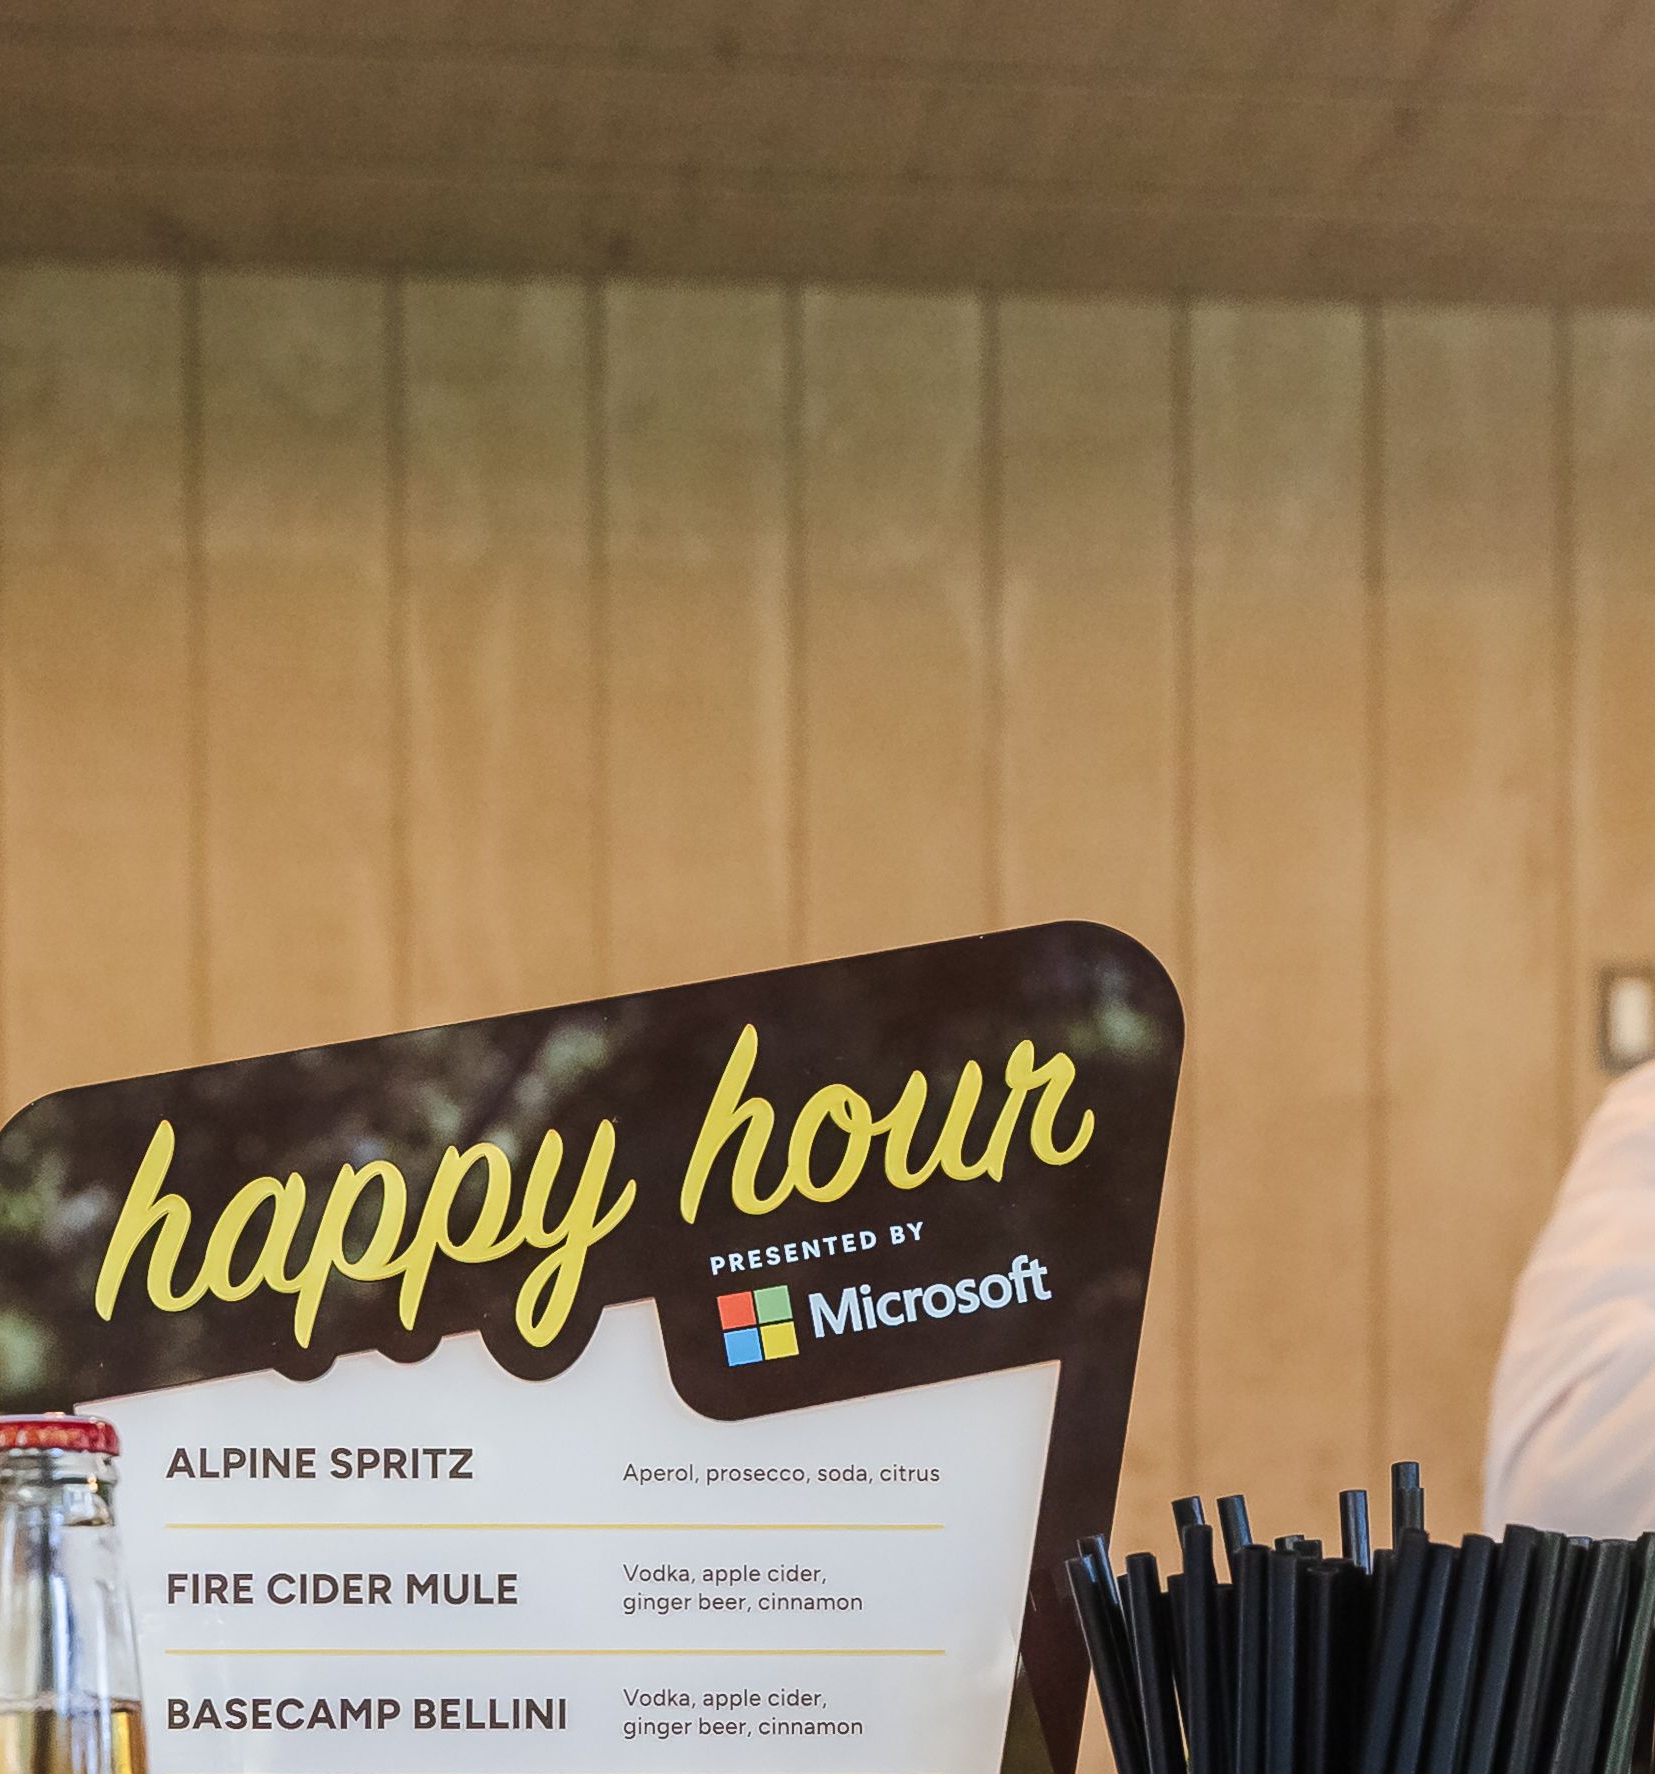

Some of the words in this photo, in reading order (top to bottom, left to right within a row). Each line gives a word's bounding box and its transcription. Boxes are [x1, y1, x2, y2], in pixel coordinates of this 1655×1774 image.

[94, 1119, 637, 1349] happy
[680, 1023, 1095, 1224] hour
[709, 1230, 877, 1276] PRESENTED
[889, 1221, 924, 1245] BY
[808, 1254, 1052, 1338] Microsoft
[165, 1447, 316, 1479] ALPINE
[330, 1447, 474, 1479] SPRITZ
[622, 1463, 699, 1486] Aperol,
[706, 1467, 811, 1486] prosecco,
[817, 1463, 873, 1485] soda,
[879, 1463, 940, 1482] citrus
[167, 1573, 254, 1605] FIRE
[267, 1573, 392, 1605] CIDER
[406, 1573, 518, 1605] MULE
[622, 1563, 696, 1585] Vodka,
[702, 1564, 761, 1587] apple
[767, 1563, 827, 1585] cider,
[623, 1592, 692, 1615] ginger
[698, 1592, 752, 1613] beer,
[758, 1592, 863, 1611] cinnamon
[167, 1697, 401, 1730] BASECAMP
[414, 1698, 566, 1730] BELLINI
[623, 1688, 696, 1710] Vodka,
[702, 1688, 762, 1711] apple
[767, 1687, 827, 1710] cider,
[623, 1716, 693, 1740] ginger
[698, 1716, 752, 1738] beer,
[758, 1716, 863, 1736] cinnamon
